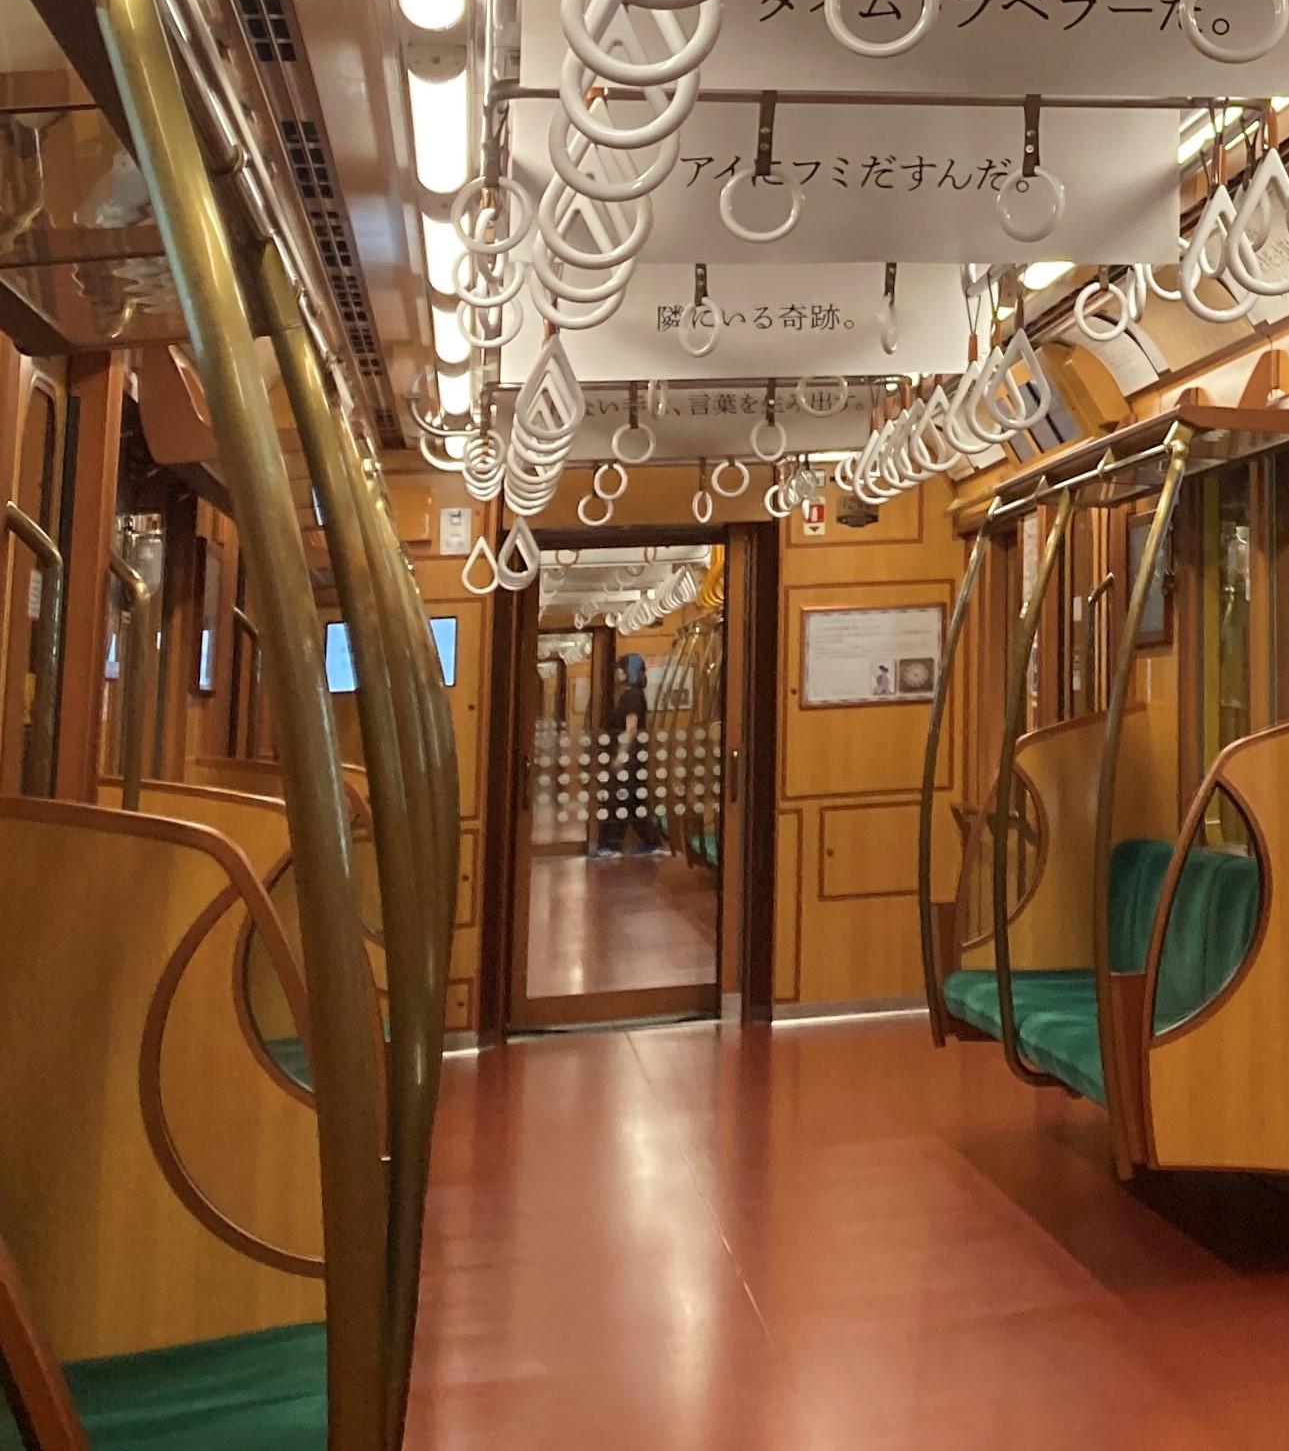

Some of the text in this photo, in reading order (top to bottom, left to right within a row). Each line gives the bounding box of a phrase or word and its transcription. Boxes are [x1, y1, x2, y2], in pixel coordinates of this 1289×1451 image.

[656, 304, 855, 332] 隣にいる奇跡。
